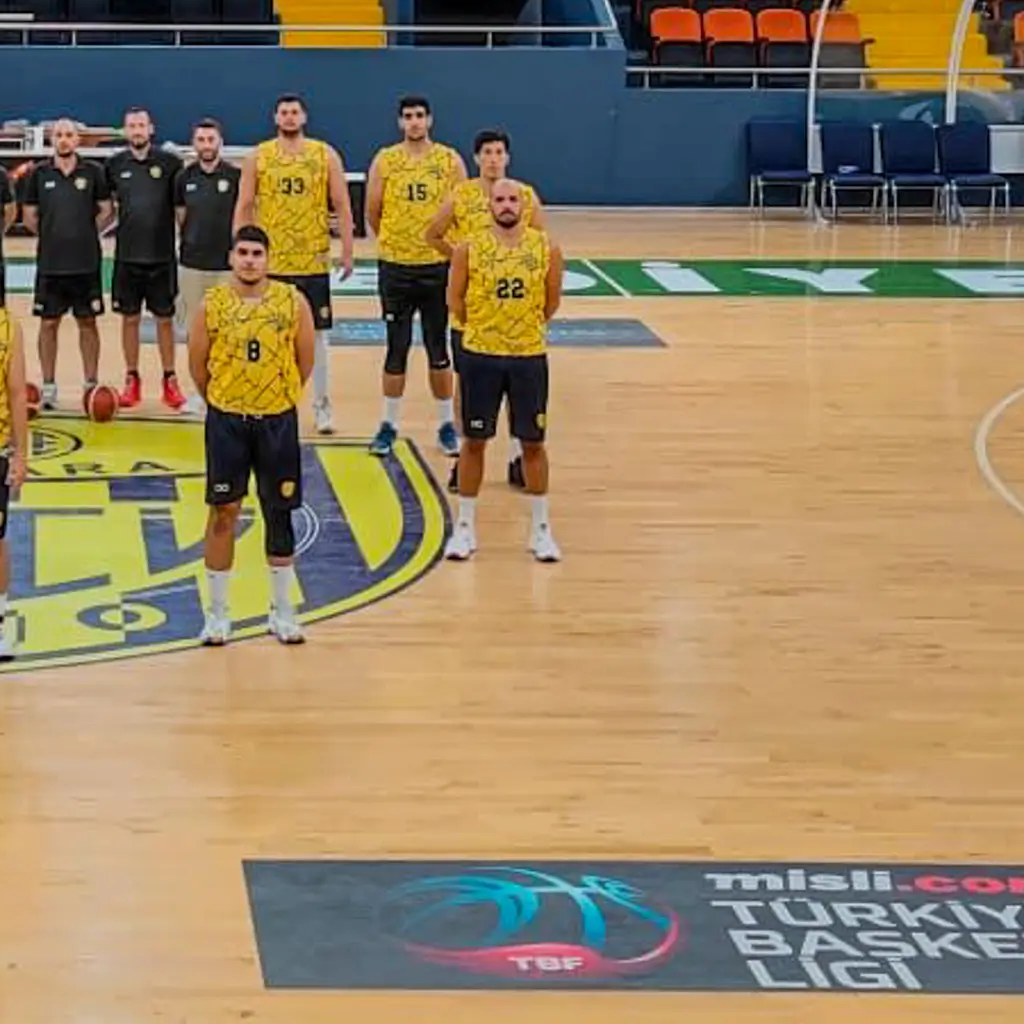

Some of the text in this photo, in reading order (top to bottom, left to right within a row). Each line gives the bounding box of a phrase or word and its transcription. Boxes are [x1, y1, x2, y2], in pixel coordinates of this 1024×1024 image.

[280, 177, 304, 194] 33
[407, 184, 426, 201] 15
[497, 278, 524, 299] 22
[247, 339, 260, 362] 8
[705, 869, 1024, 893] misli.co
[506, 956, 584, 971] TBF
[746, 956, 923, 989] LİGİ
